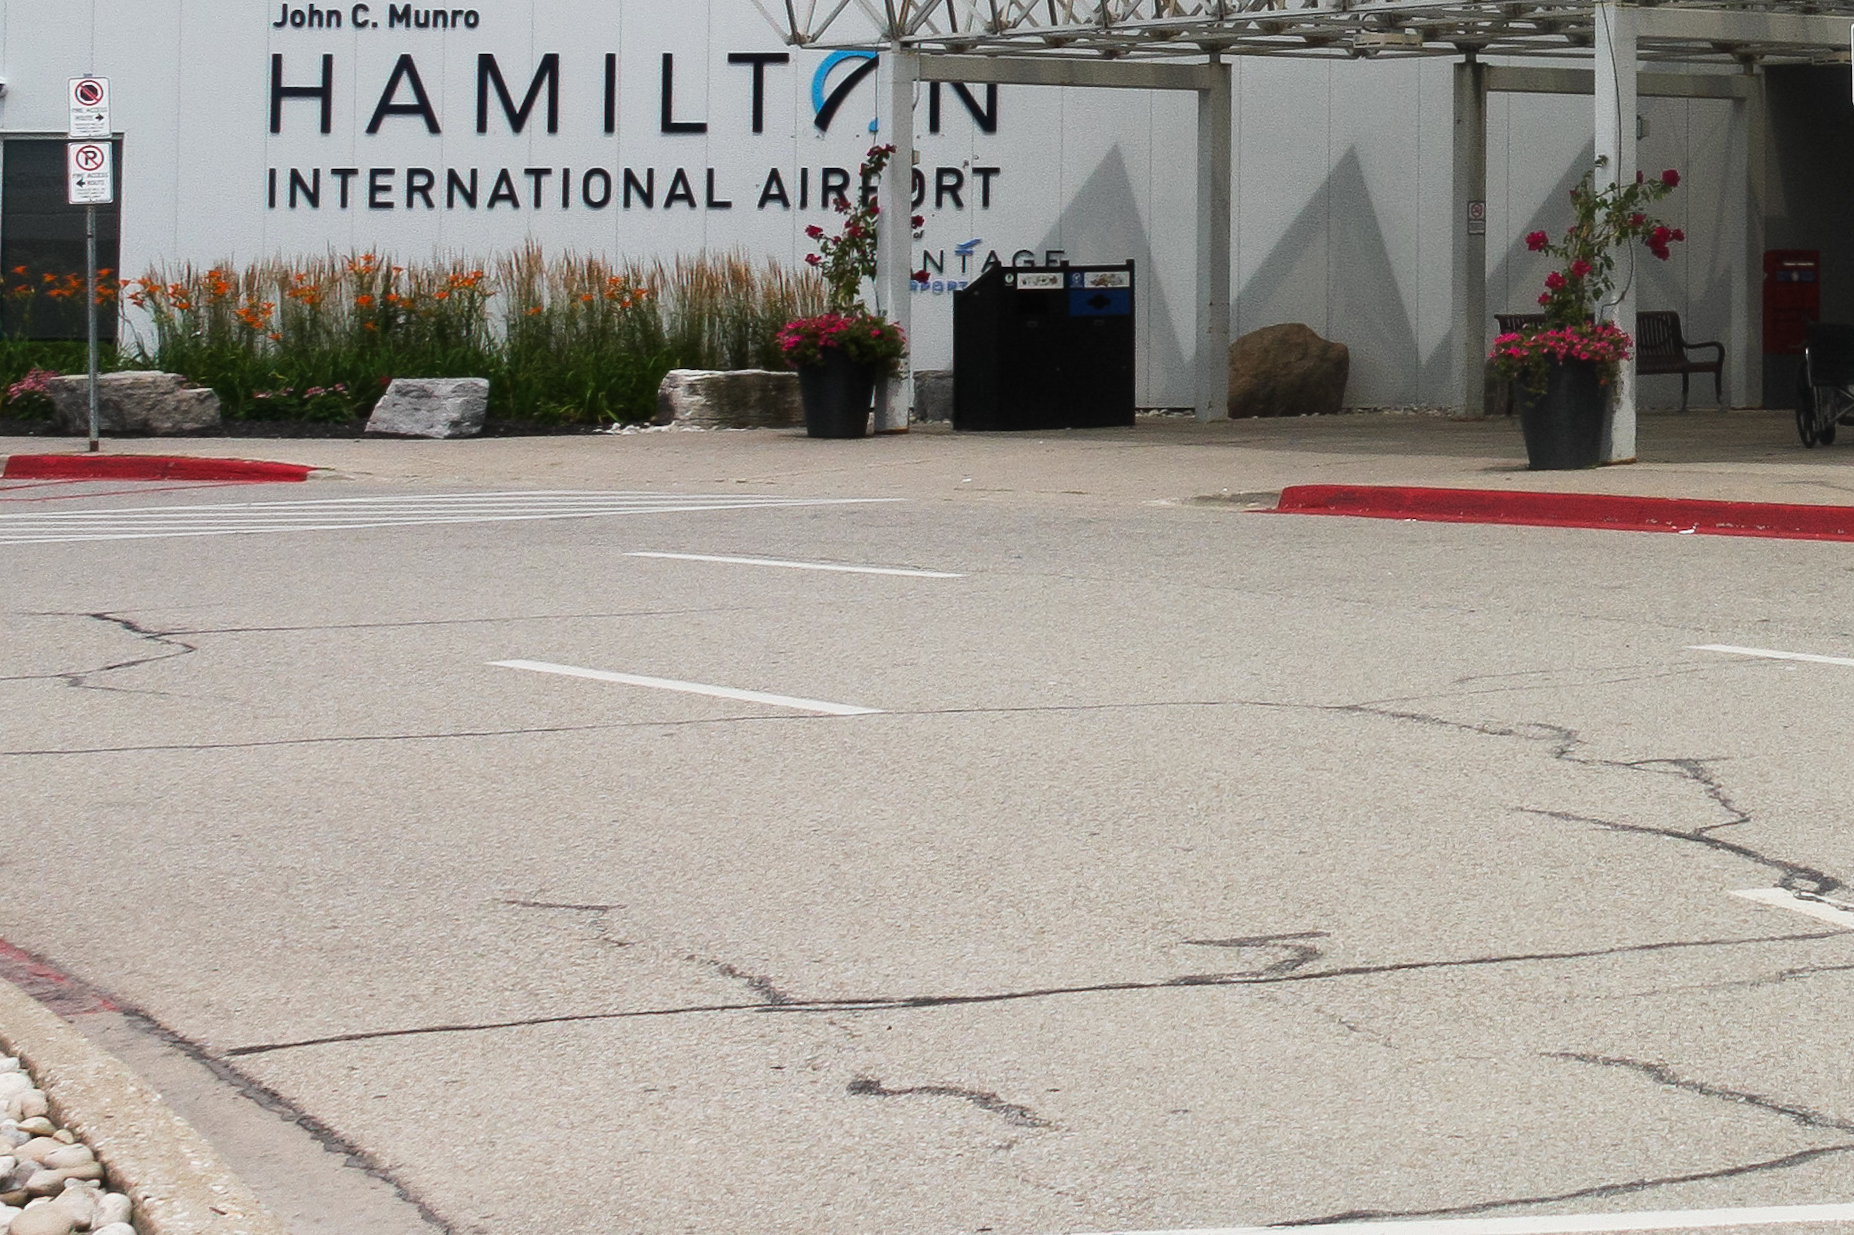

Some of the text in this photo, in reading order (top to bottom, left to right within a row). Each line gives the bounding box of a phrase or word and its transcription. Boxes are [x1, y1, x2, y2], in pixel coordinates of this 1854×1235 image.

[272, 3, 481, 29] John C. Munro
[268, 167, 732, 209] INTERNATIONAL
